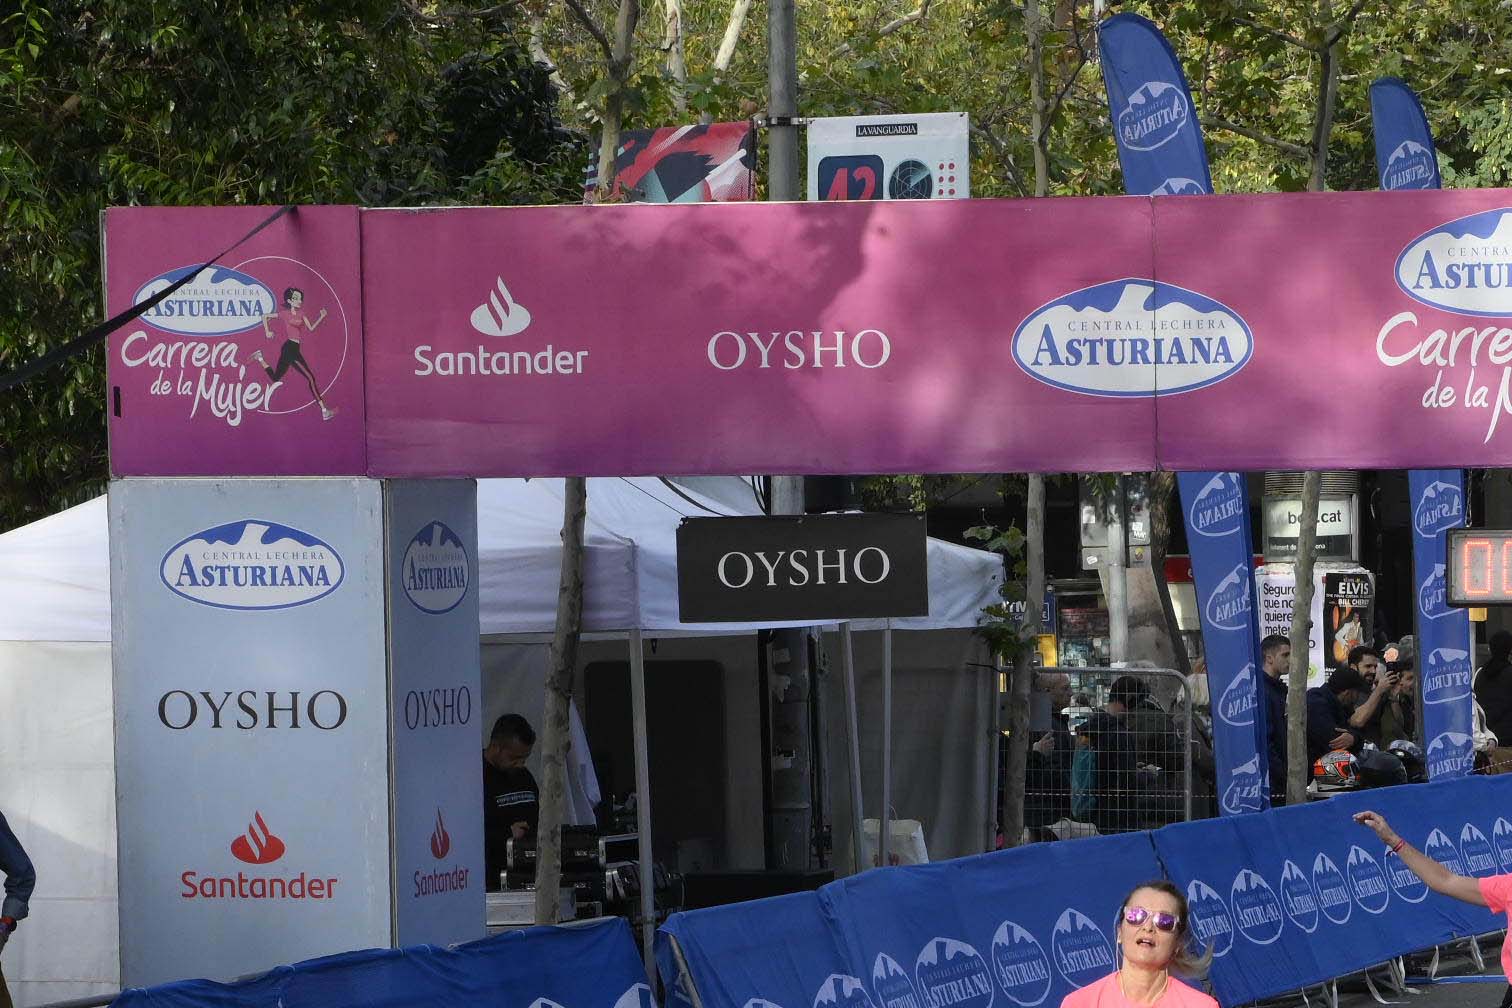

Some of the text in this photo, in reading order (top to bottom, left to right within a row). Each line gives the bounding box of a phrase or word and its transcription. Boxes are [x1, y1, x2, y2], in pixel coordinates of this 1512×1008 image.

[1067, 318, 1227, 332] CENTRAL LECHERA
[120, 330, 239, 368] Carrera
[413, 345, 589, 376] Santander
[706, 328, 891, 370] OYSHO
[1030, 323, 1235, 368] ASTURIANA
[150, 365, 284, 427] de la Mujer
[1421, 369, 1456, 409] de
[1464, 367, 1489, 409] la
[175, 553, 332, 588] ASTURIANA
[202, 551, 325, 561] CENTRAL LECHERA
[407, 555, 466, 591] ASTURIANA
[716, 546, 891, 589] OYSHO
[1264, 599, 1280, 611] que
[1338, 582, 1369, 595] ELVIS
[1264, 611, 1294, 623] quiere
[157, 689, 348, 730] OYSHO
[405, 685, 472, 731] OYSHO
[181, 871, 338, 899] Santander
[413, 866, 470, 899] Santander
